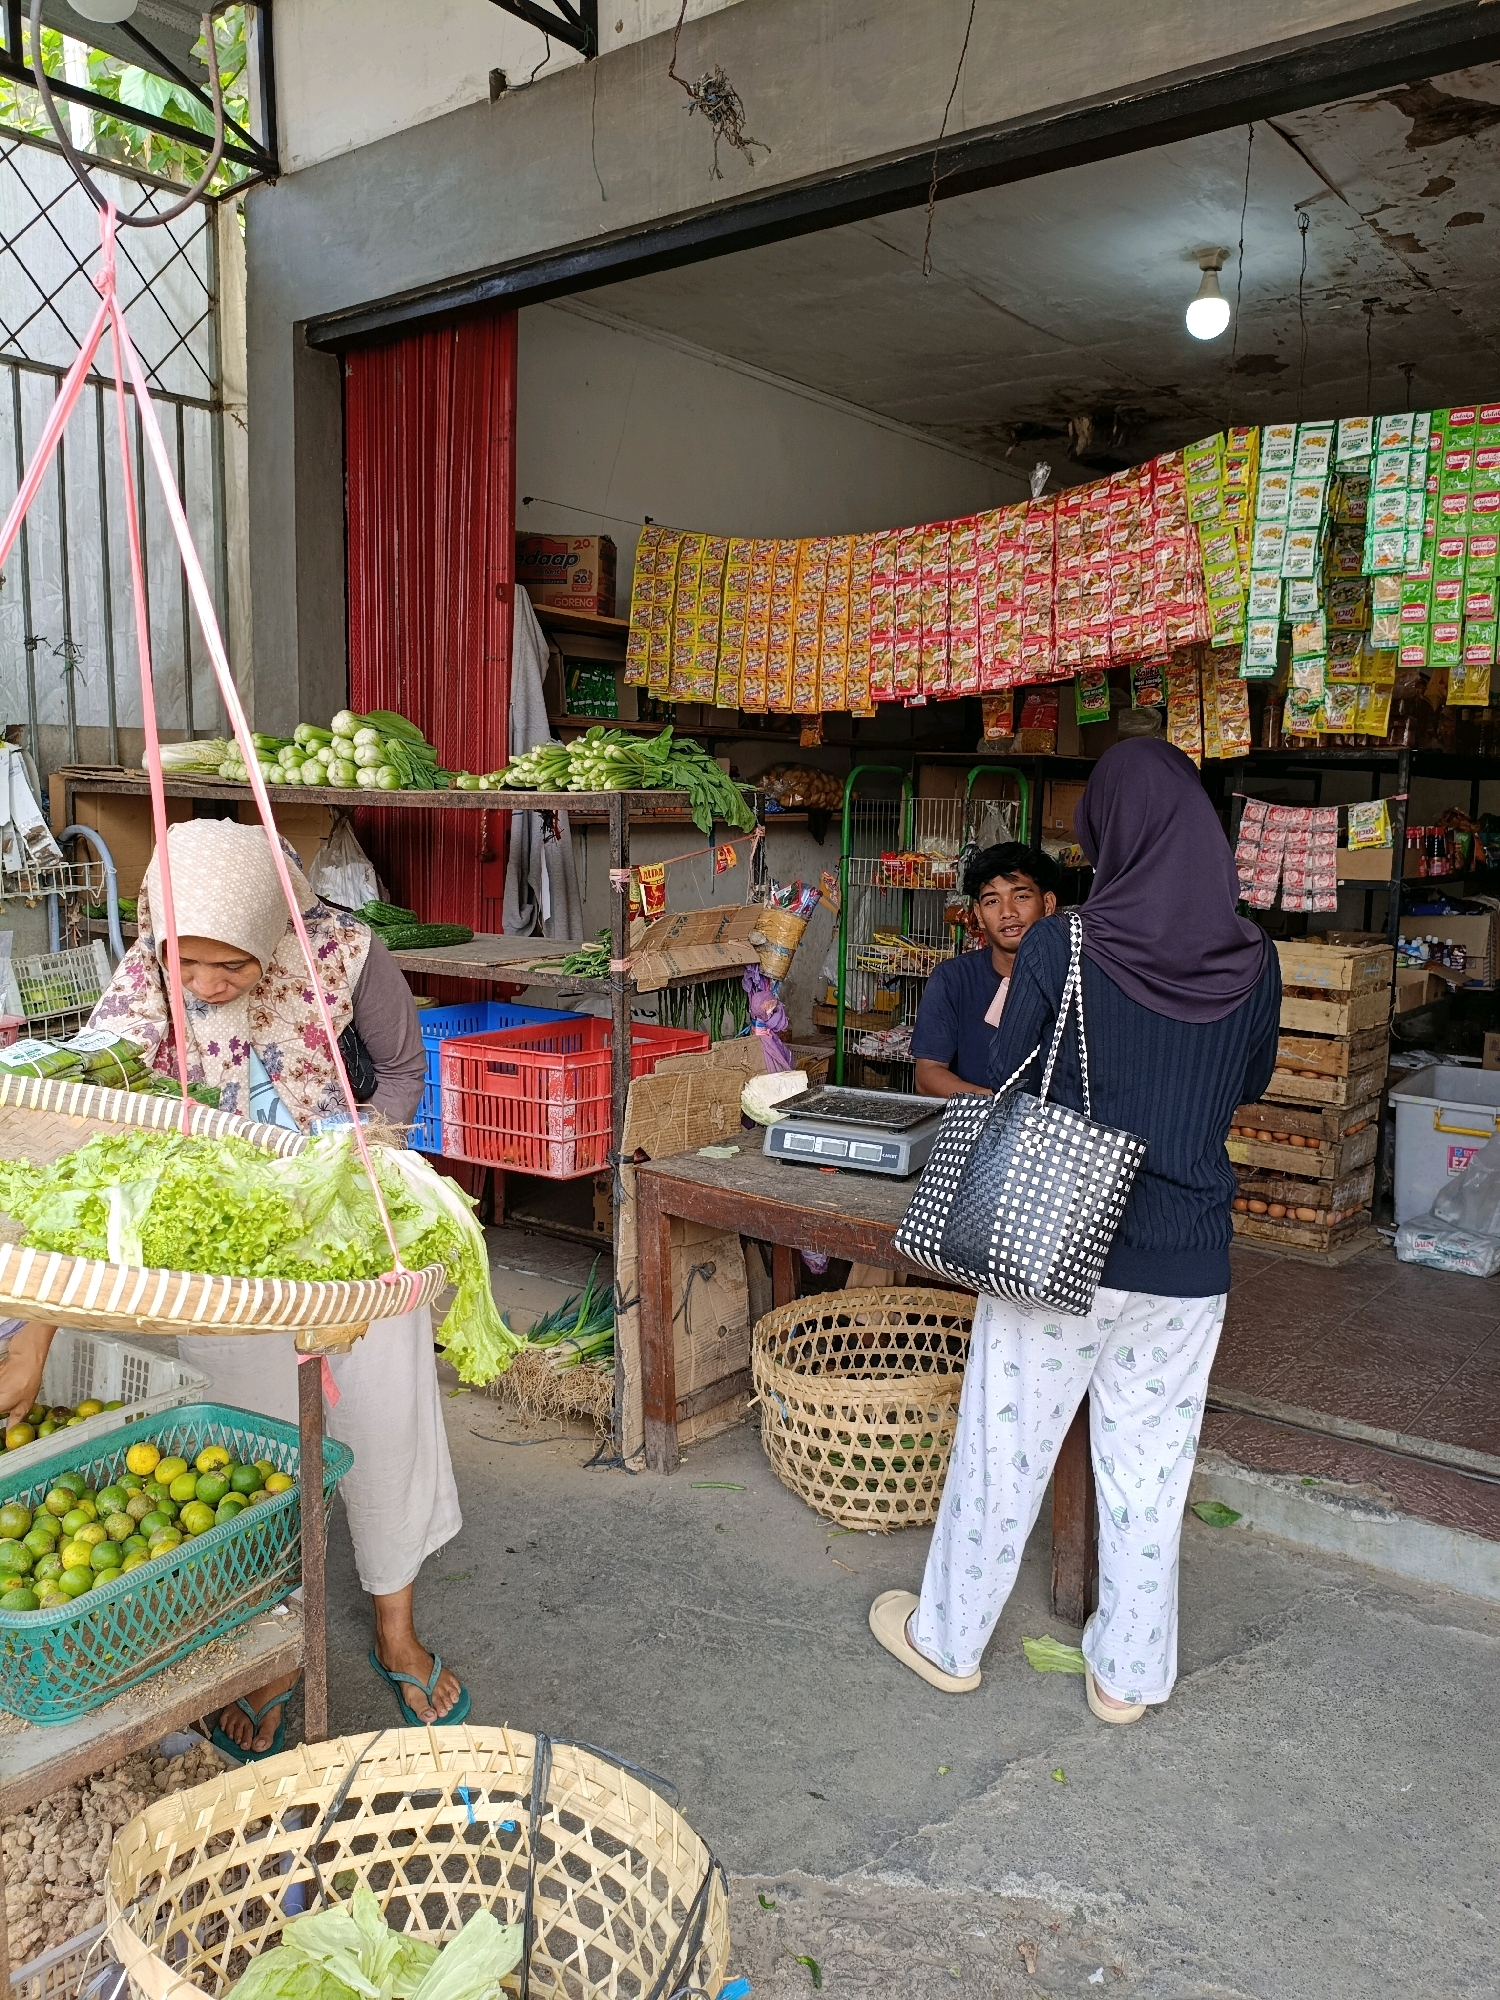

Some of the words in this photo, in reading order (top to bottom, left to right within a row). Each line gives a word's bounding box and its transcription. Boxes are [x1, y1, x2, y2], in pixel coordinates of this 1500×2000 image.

[572, 539, 591, 551] 20
[516, 549, 580, 571] edaap
[554, 598, 594, 607] GORENG
[643, 867, 664, 880] AIDA
[1452, 1157, 1468, 1169] EZ
